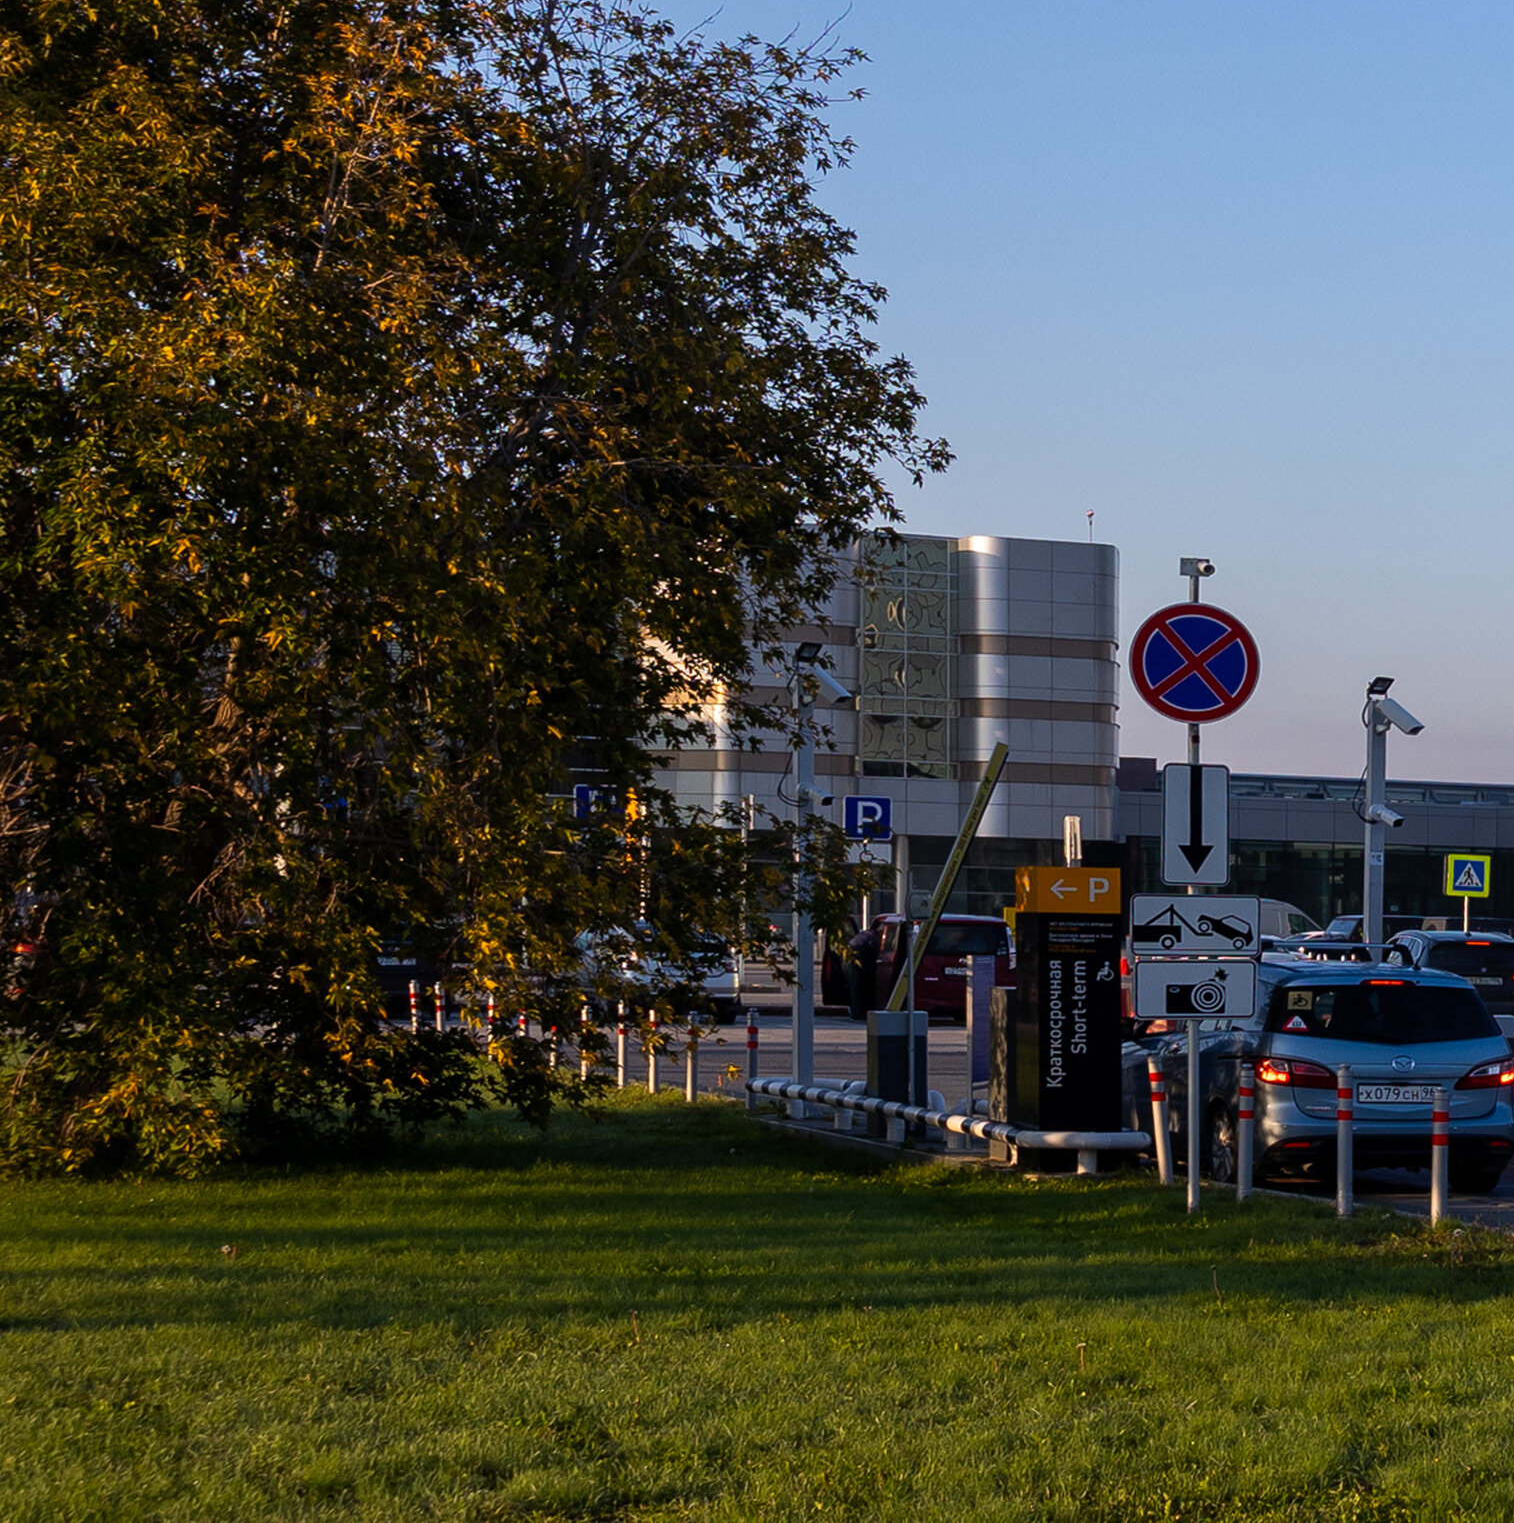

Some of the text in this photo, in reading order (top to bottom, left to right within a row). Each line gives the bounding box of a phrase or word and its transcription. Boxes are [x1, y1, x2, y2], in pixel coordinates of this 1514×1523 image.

[1089, 877, 1109, 902] P
[1046, 960, 1066, 1088] Краткосрочная
[1071, 960, 1087, 1054] Short-term
